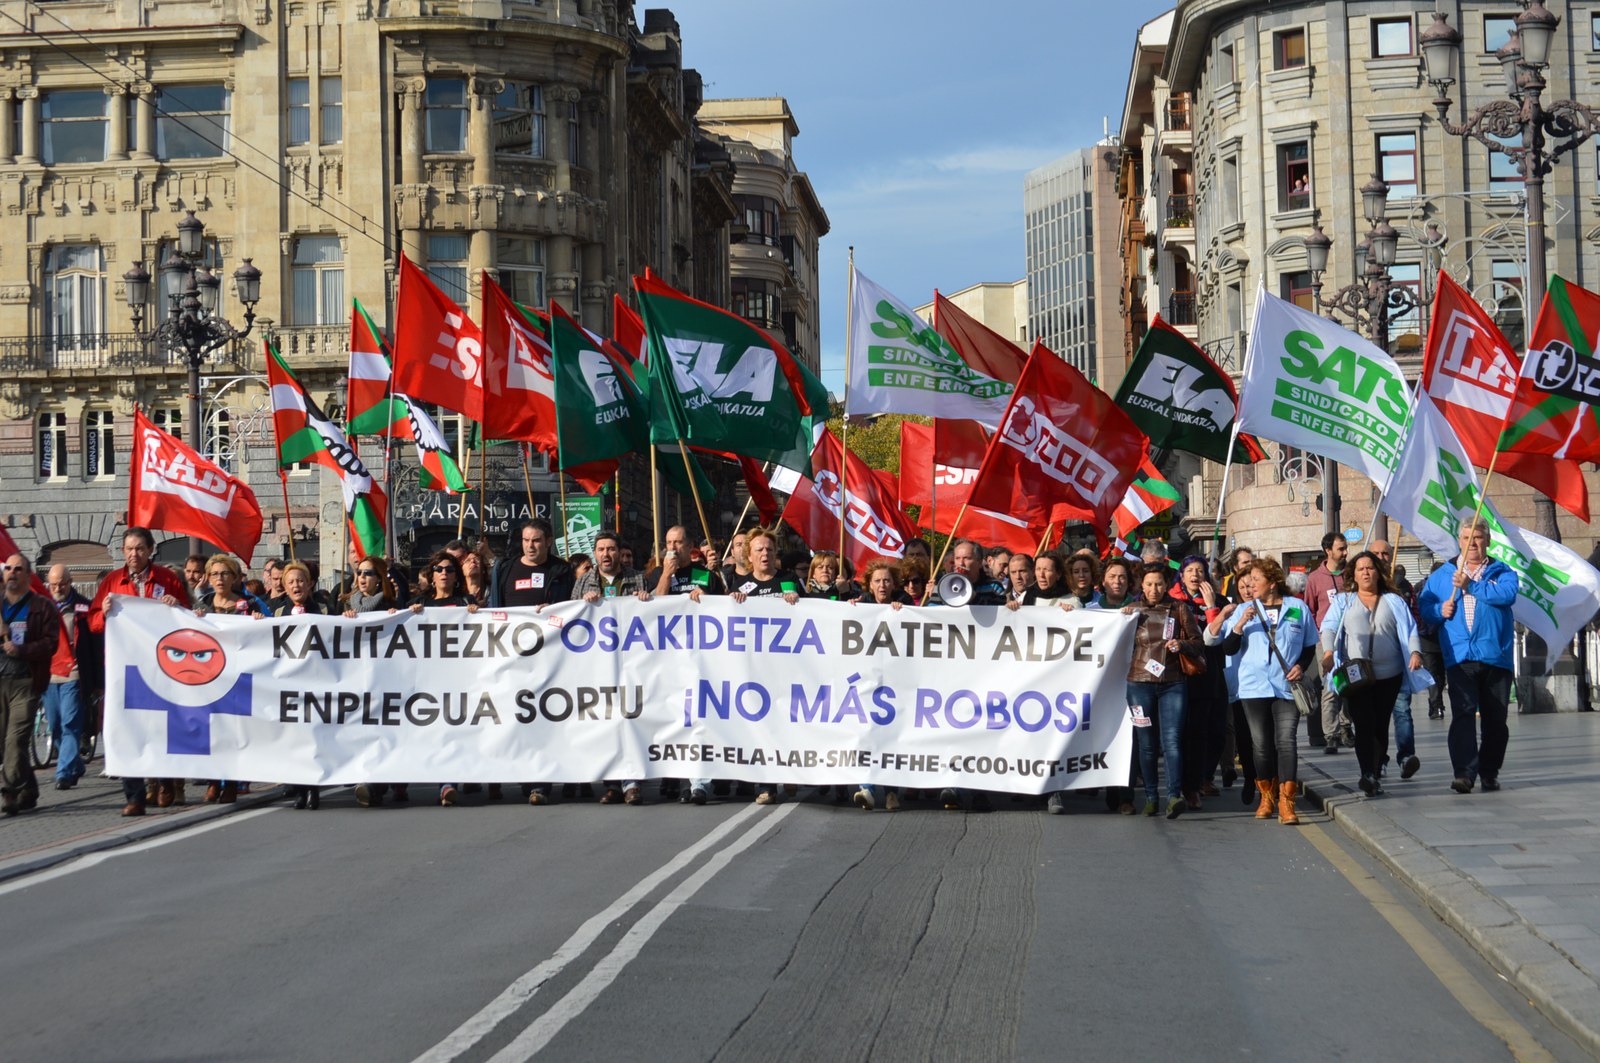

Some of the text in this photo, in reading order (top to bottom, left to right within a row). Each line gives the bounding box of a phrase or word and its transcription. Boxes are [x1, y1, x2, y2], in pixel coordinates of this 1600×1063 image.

[662, 335, 777, 402] ELA
[1280, 330, 1411, 427] SATS
[1443, 322, 1517, 394] LA
[1127, 394, 1170, 418] EUSKAL
[1133, 352, 1236, 432] ELA
[1291, 386, 1389, 437] SINDICATO
[42, 433, 51, 471] fitness
[89, 431, 97, 473] GIMNASIO
[1290, 408, 1399, 471] ENFERMERI
[411, 503, 552, 519] BARANDIAR
[272, 614, 1106, 669] KALITATEZKO OSAKIDETZA BATEN ALDE,
[280, 671, 1092, 733] ENPLEGUA SORTU ¡NO MÁS ROBOS!
[648, 743, 1109, 778] SATSE-ELA-LAB-SME-FFHE-CCOO-UGT-ESK
